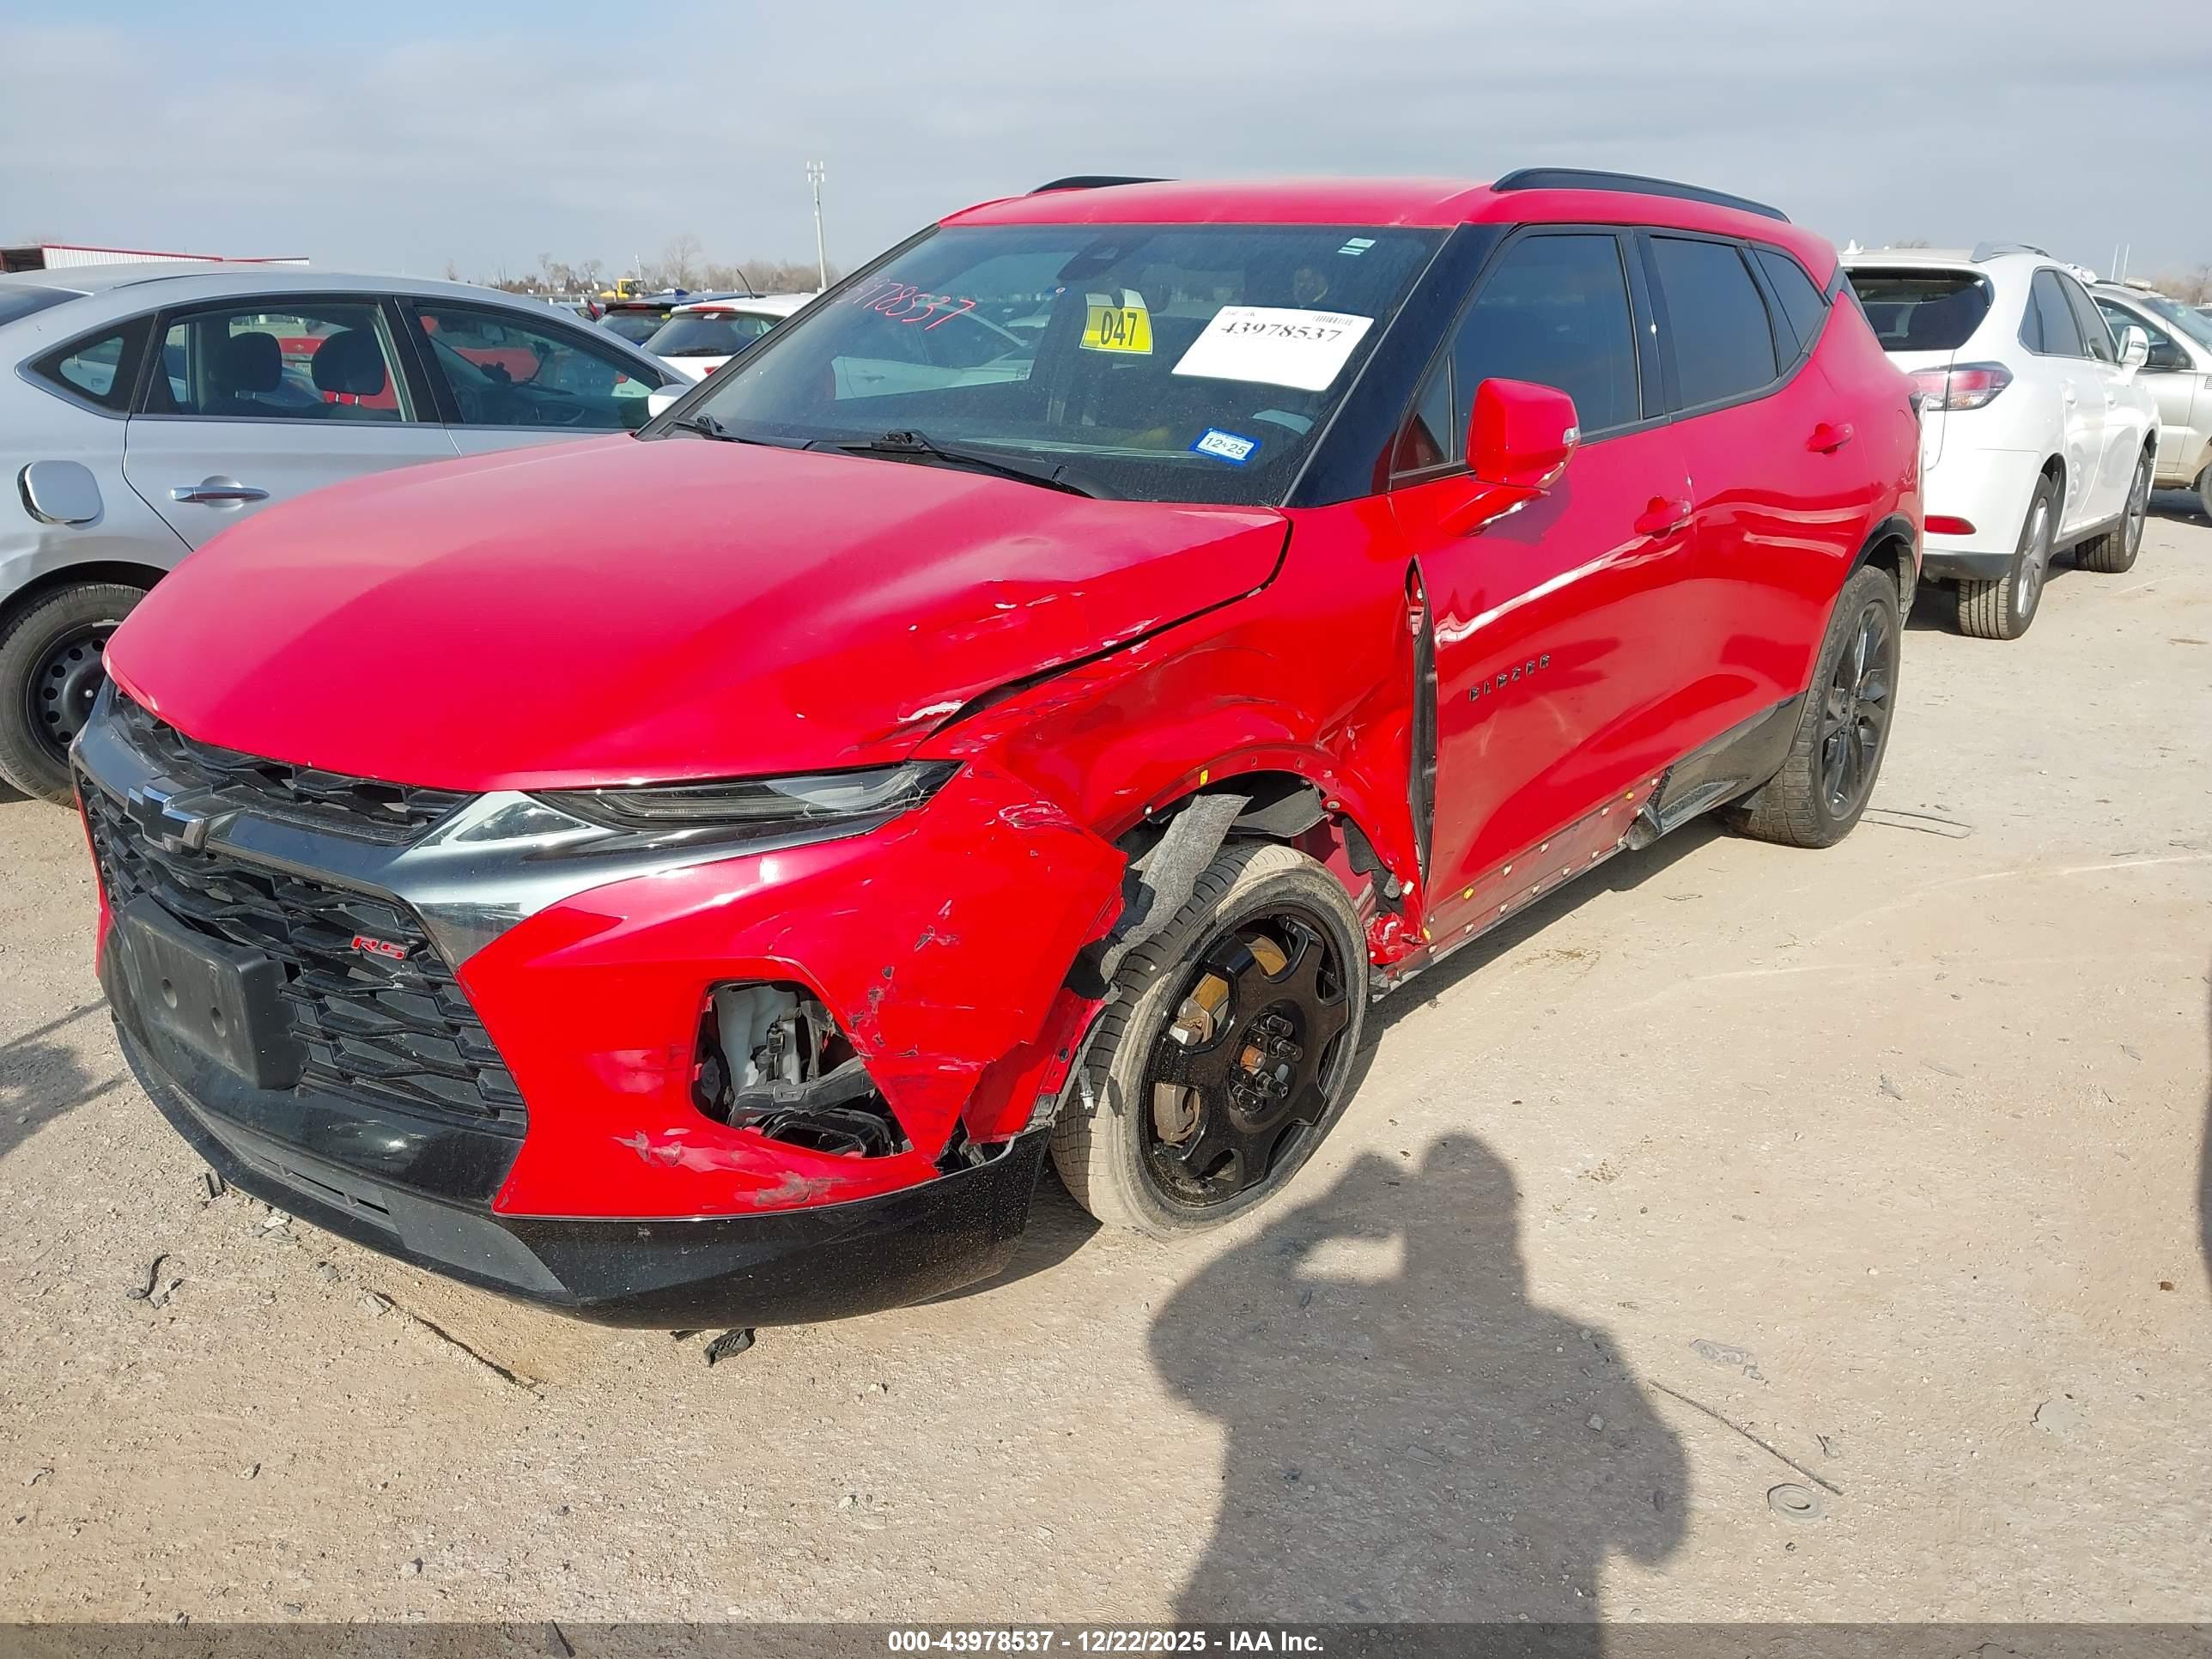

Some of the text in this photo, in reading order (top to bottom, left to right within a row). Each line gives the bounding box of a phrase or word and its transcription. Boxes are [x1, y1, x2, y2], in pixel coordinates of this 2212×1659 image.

[1100, 310, 1138, 347] 047
[1220, 321, 1344, 343] 43978537
[1469, 654, 1550, 702] BLAZER
[350, 934, 407, 960] RS
